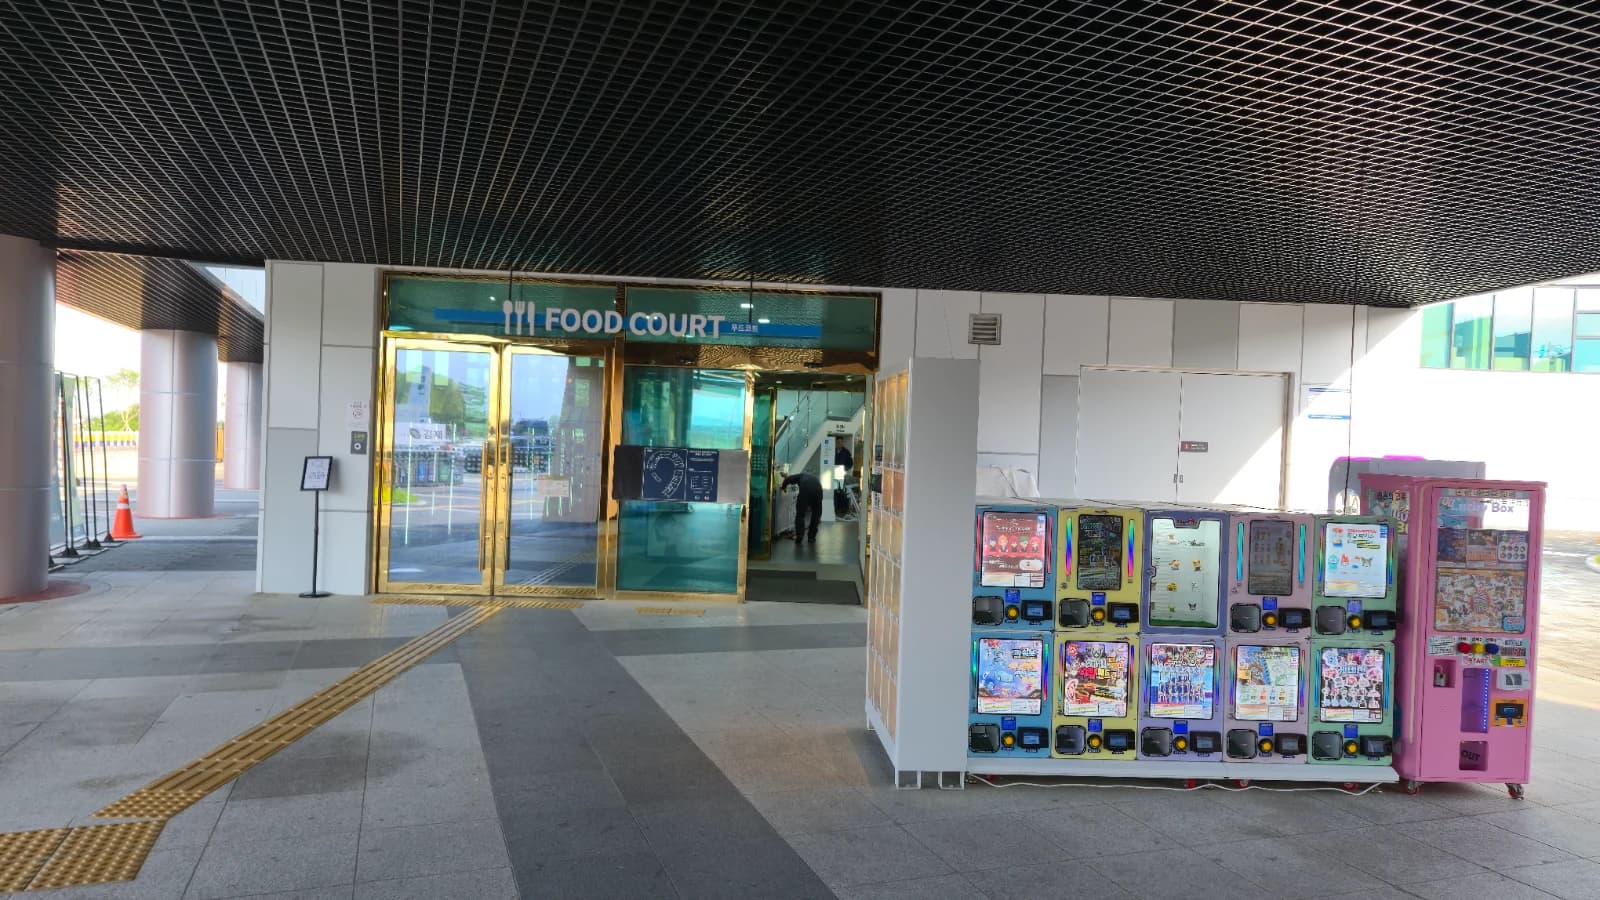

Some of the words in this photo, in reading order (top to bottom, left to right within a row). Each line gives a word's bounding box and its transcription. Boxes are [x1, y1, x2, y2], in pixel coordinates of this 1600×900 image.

[546, 308, 622, 334] FOOD
[629, 312, 726, 338] COURT
[1491, 502, 1514, 513] Box
[1461, 750, 1481, 761] OUT
